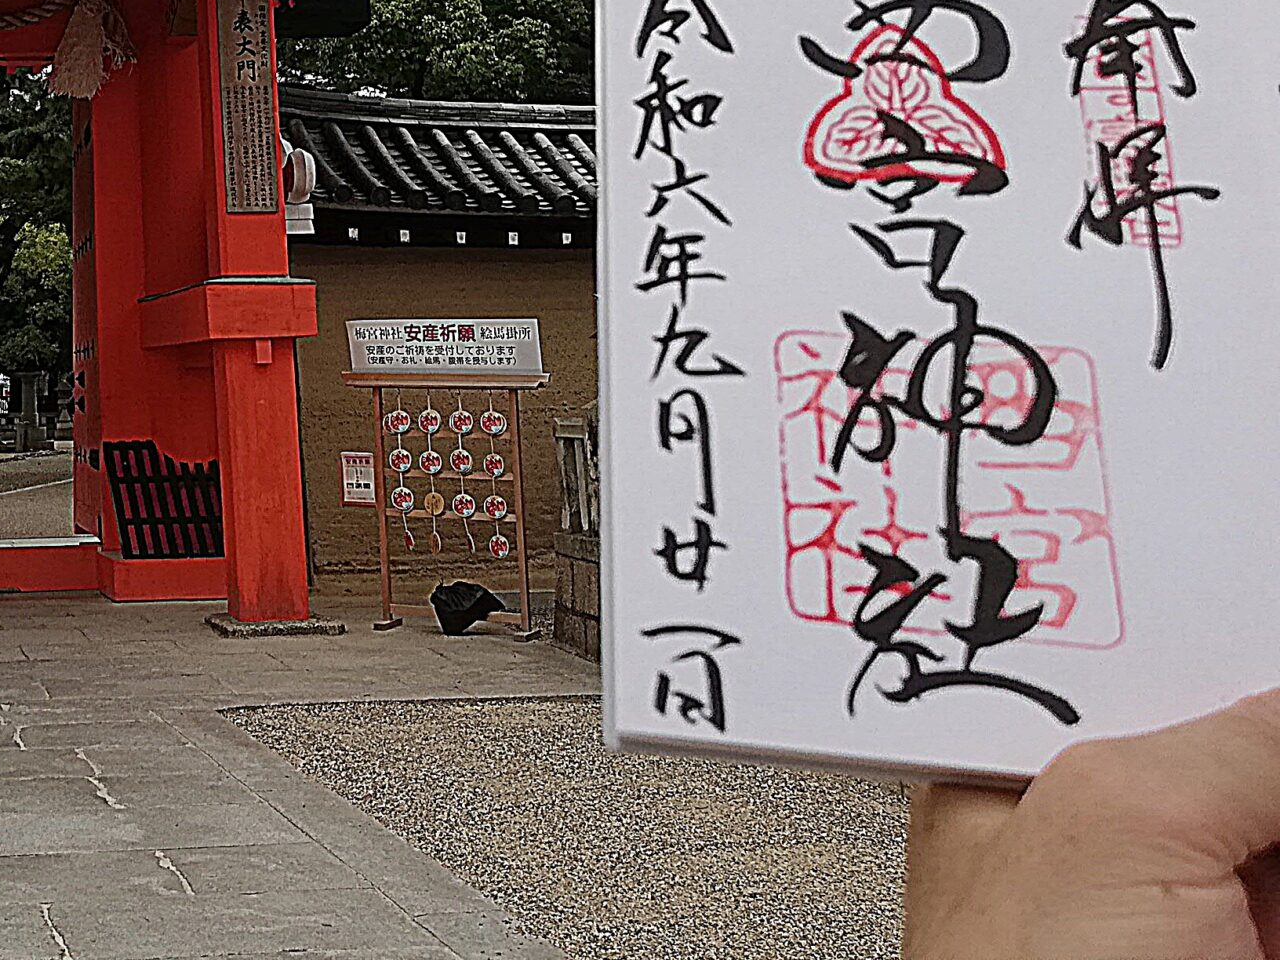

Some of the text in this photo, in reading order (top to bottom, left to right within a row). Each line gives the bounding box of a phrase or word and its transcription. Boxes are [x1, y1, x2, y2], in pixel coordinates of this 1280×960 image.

[232, 8, 257, 82] 表大門
[403, 323, 477, 343] 安産祈願
[479, 326, 532, 340] 絵馬掛所
